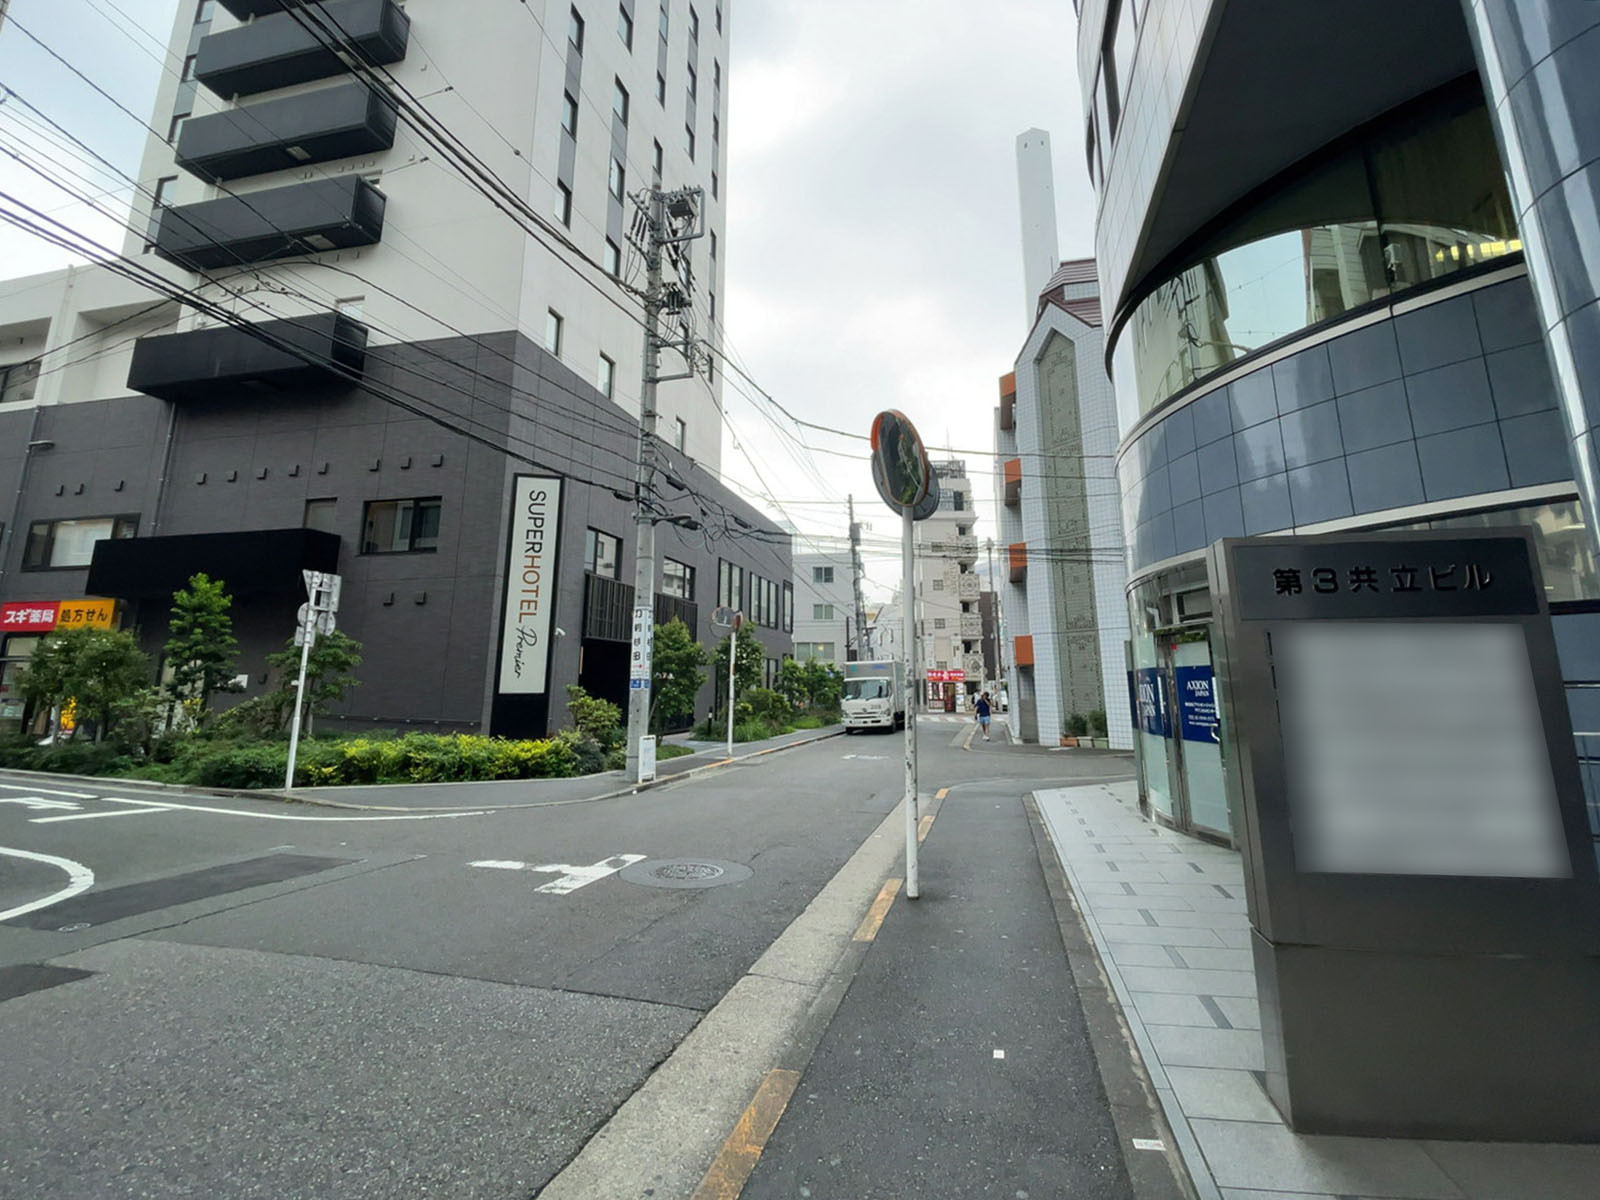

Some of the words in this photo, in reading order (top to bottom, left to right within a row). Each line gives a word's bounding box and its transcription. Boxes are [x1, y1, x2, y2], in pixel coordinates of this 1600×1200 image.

[1272, 563, 1494, 597] 第3共立ビル
[4, 608, 55, 624] スギ薬局
[61, 608, 108, 623] 処方せん
[513, 625, 538, 679] Premier
[1186, 680, 1209, 691] AXION
